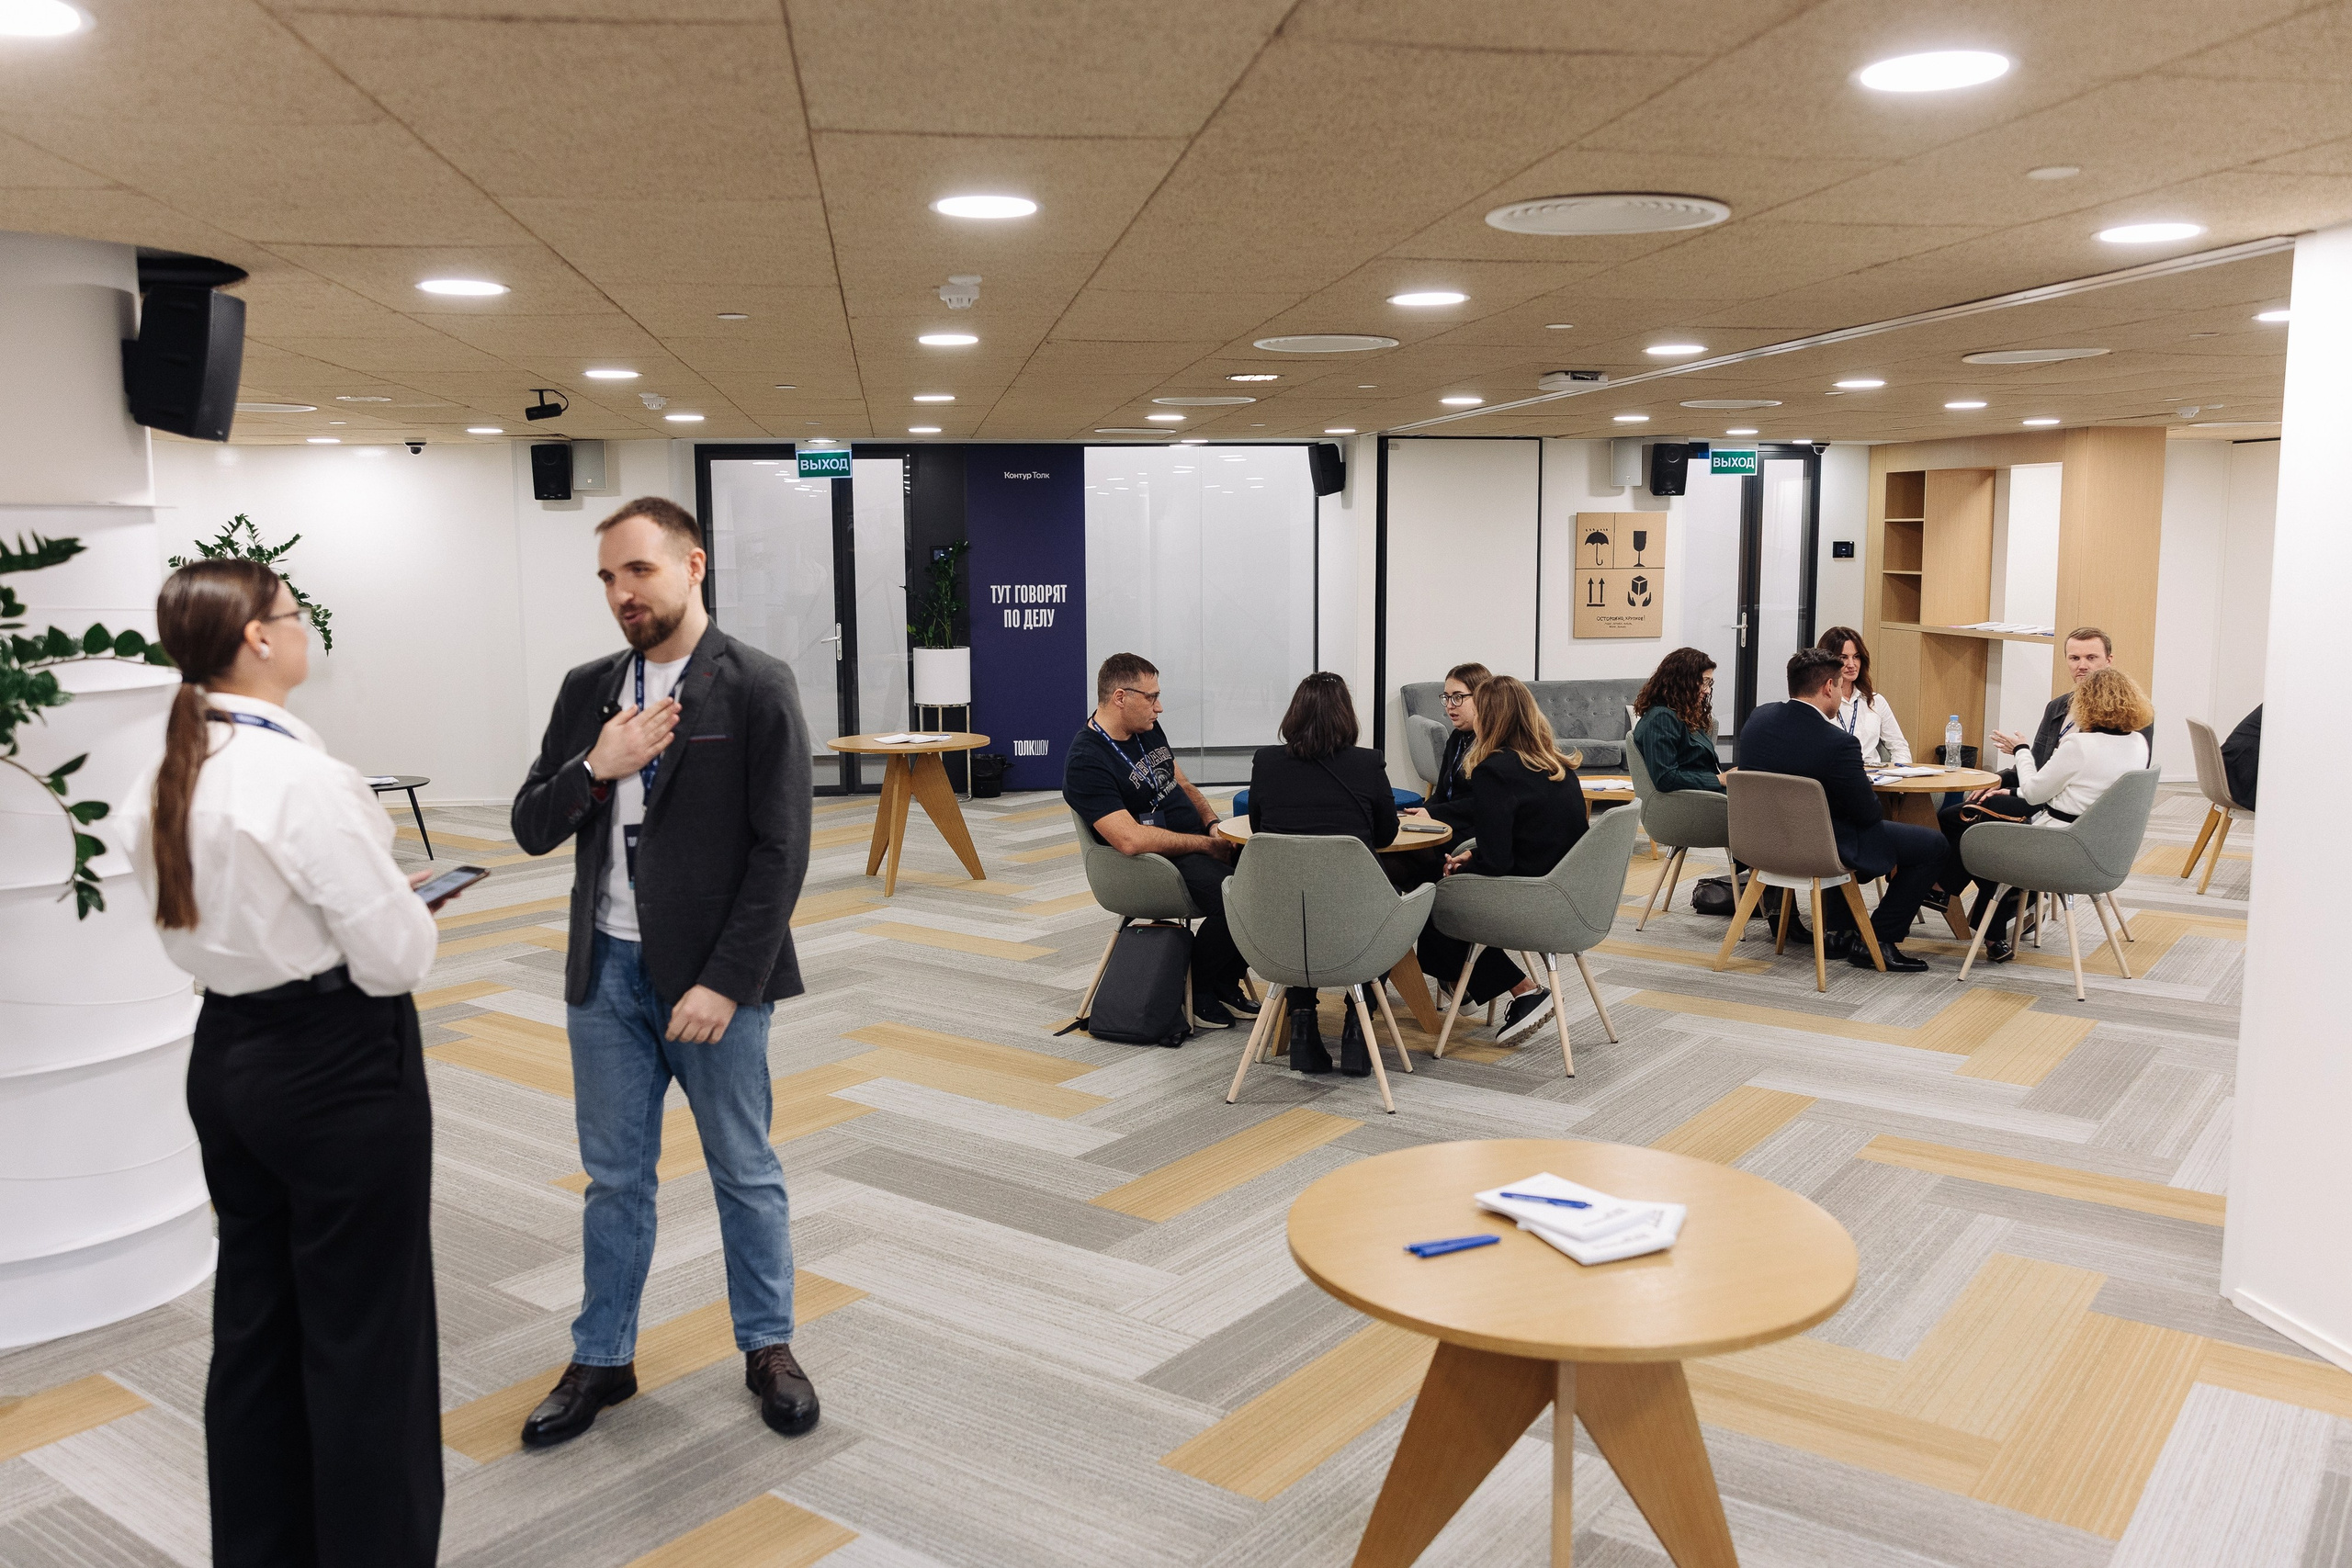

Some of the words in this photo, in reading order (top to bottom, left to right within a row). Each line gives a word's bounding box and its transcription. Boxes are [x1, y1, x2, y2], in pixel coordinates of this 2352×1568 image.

[800, 458, 849, 470] ВЫХОД
[1713, 457, 1755, 469] ВЫХОД
[1004, 471, 1032, 480] Контур
[1032, 470, 1050, 479] Толк
[990, 585, 1012, 604] ТУТ
[1014, 584, 1068, 604] ГОВОРЯТ
[1004, 609, 1021, 628] ПО
[1023, 608, 1056, 630] ДЕЛУ
[1013, 739, 1049, 756] ТОЛКШОУ
